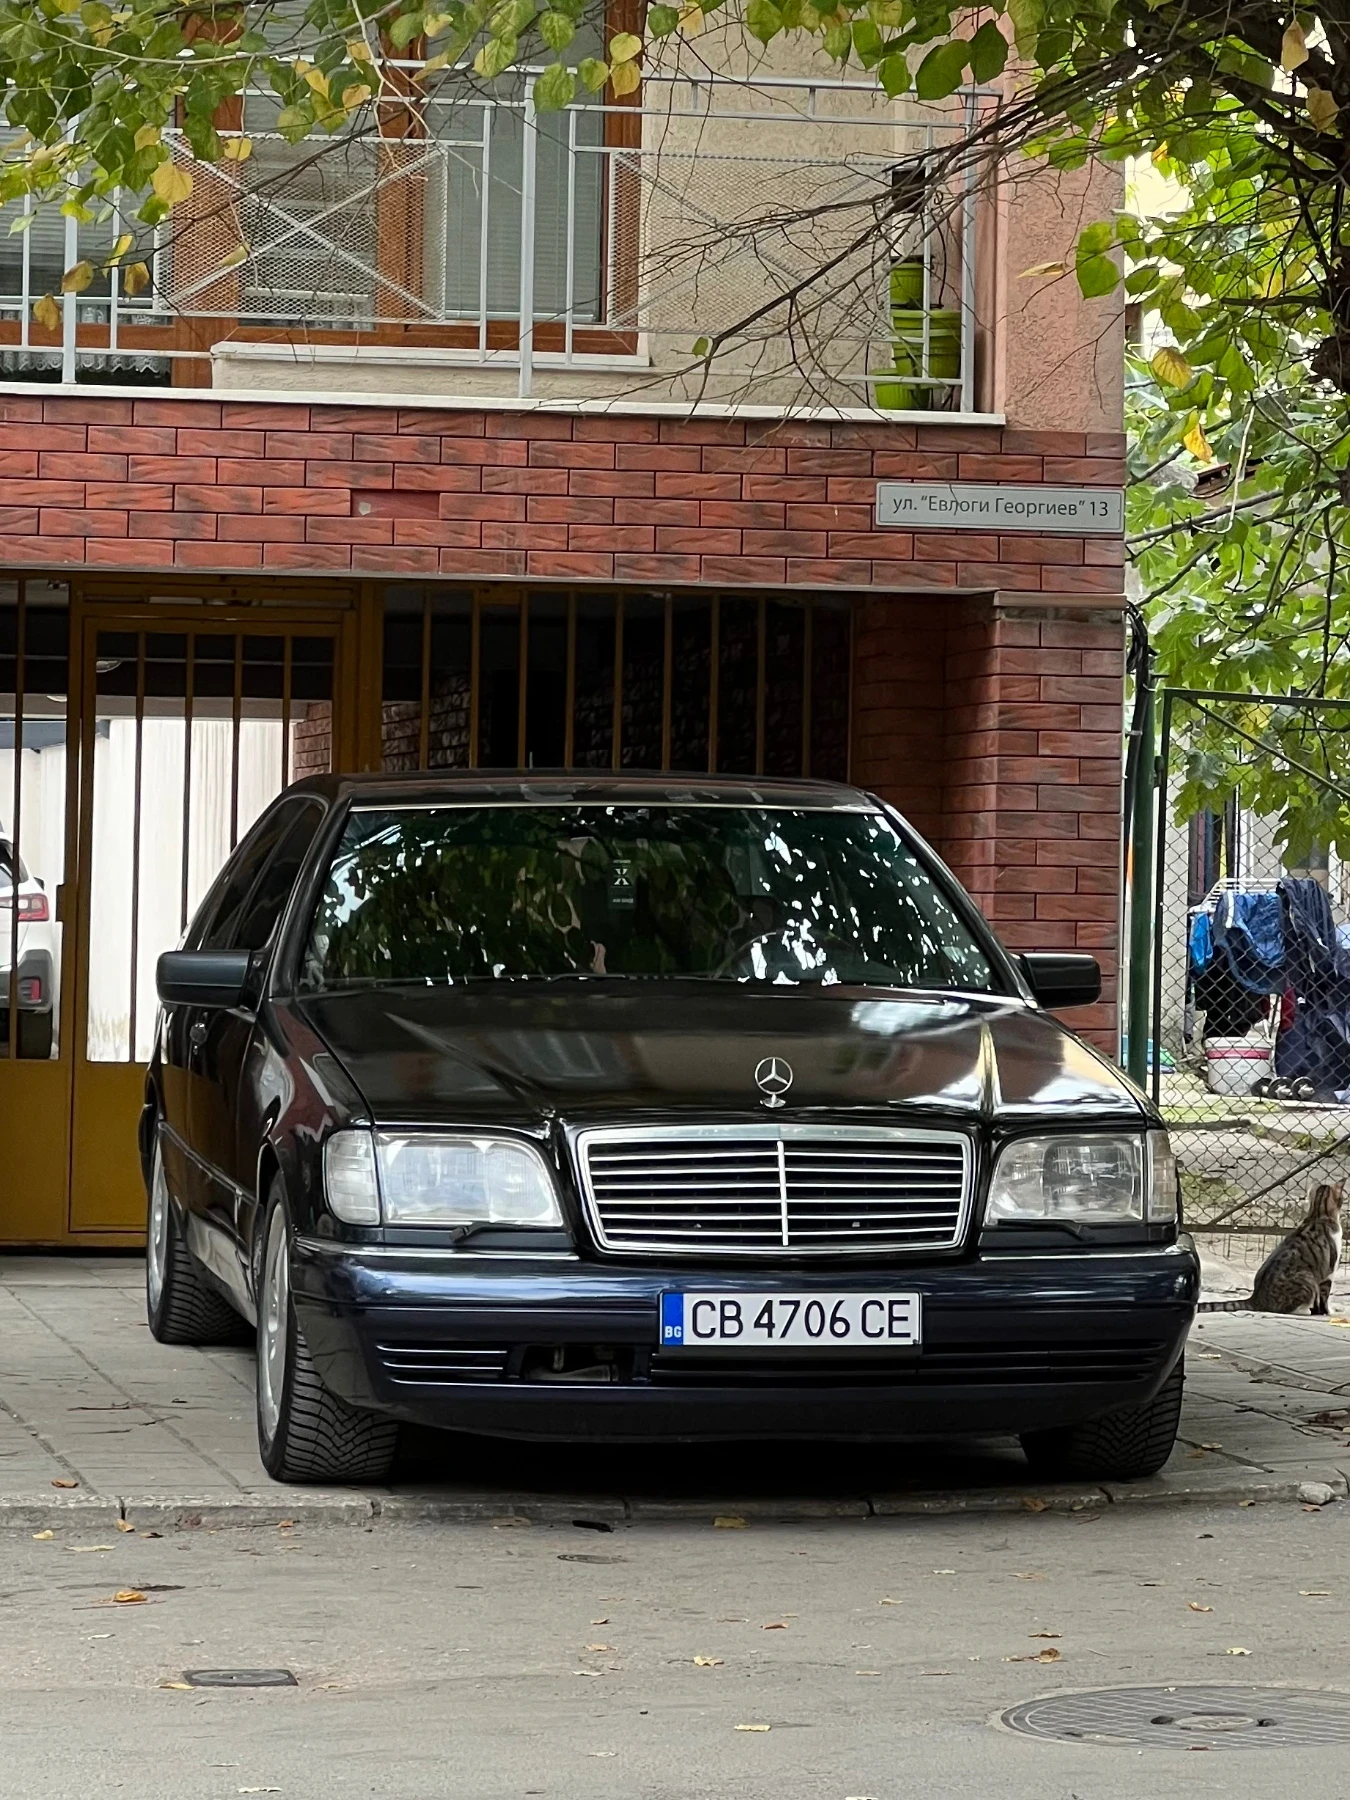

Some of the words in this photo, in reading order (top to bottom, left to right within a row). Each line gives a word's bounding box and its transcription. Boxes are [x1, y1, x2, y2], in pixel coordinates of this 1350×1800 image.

[893, 498, 917, 513] ул.
[995, 497, 1085, 518] Георгиев”
[1089, 501, 1108, 517] 13
[691, 1300, 743, 1338] CB
[753, 1300, 850, 1338] 4706
[861, 1300, 911, 1338] CE
[664, 1325, 682, 1338] BG
